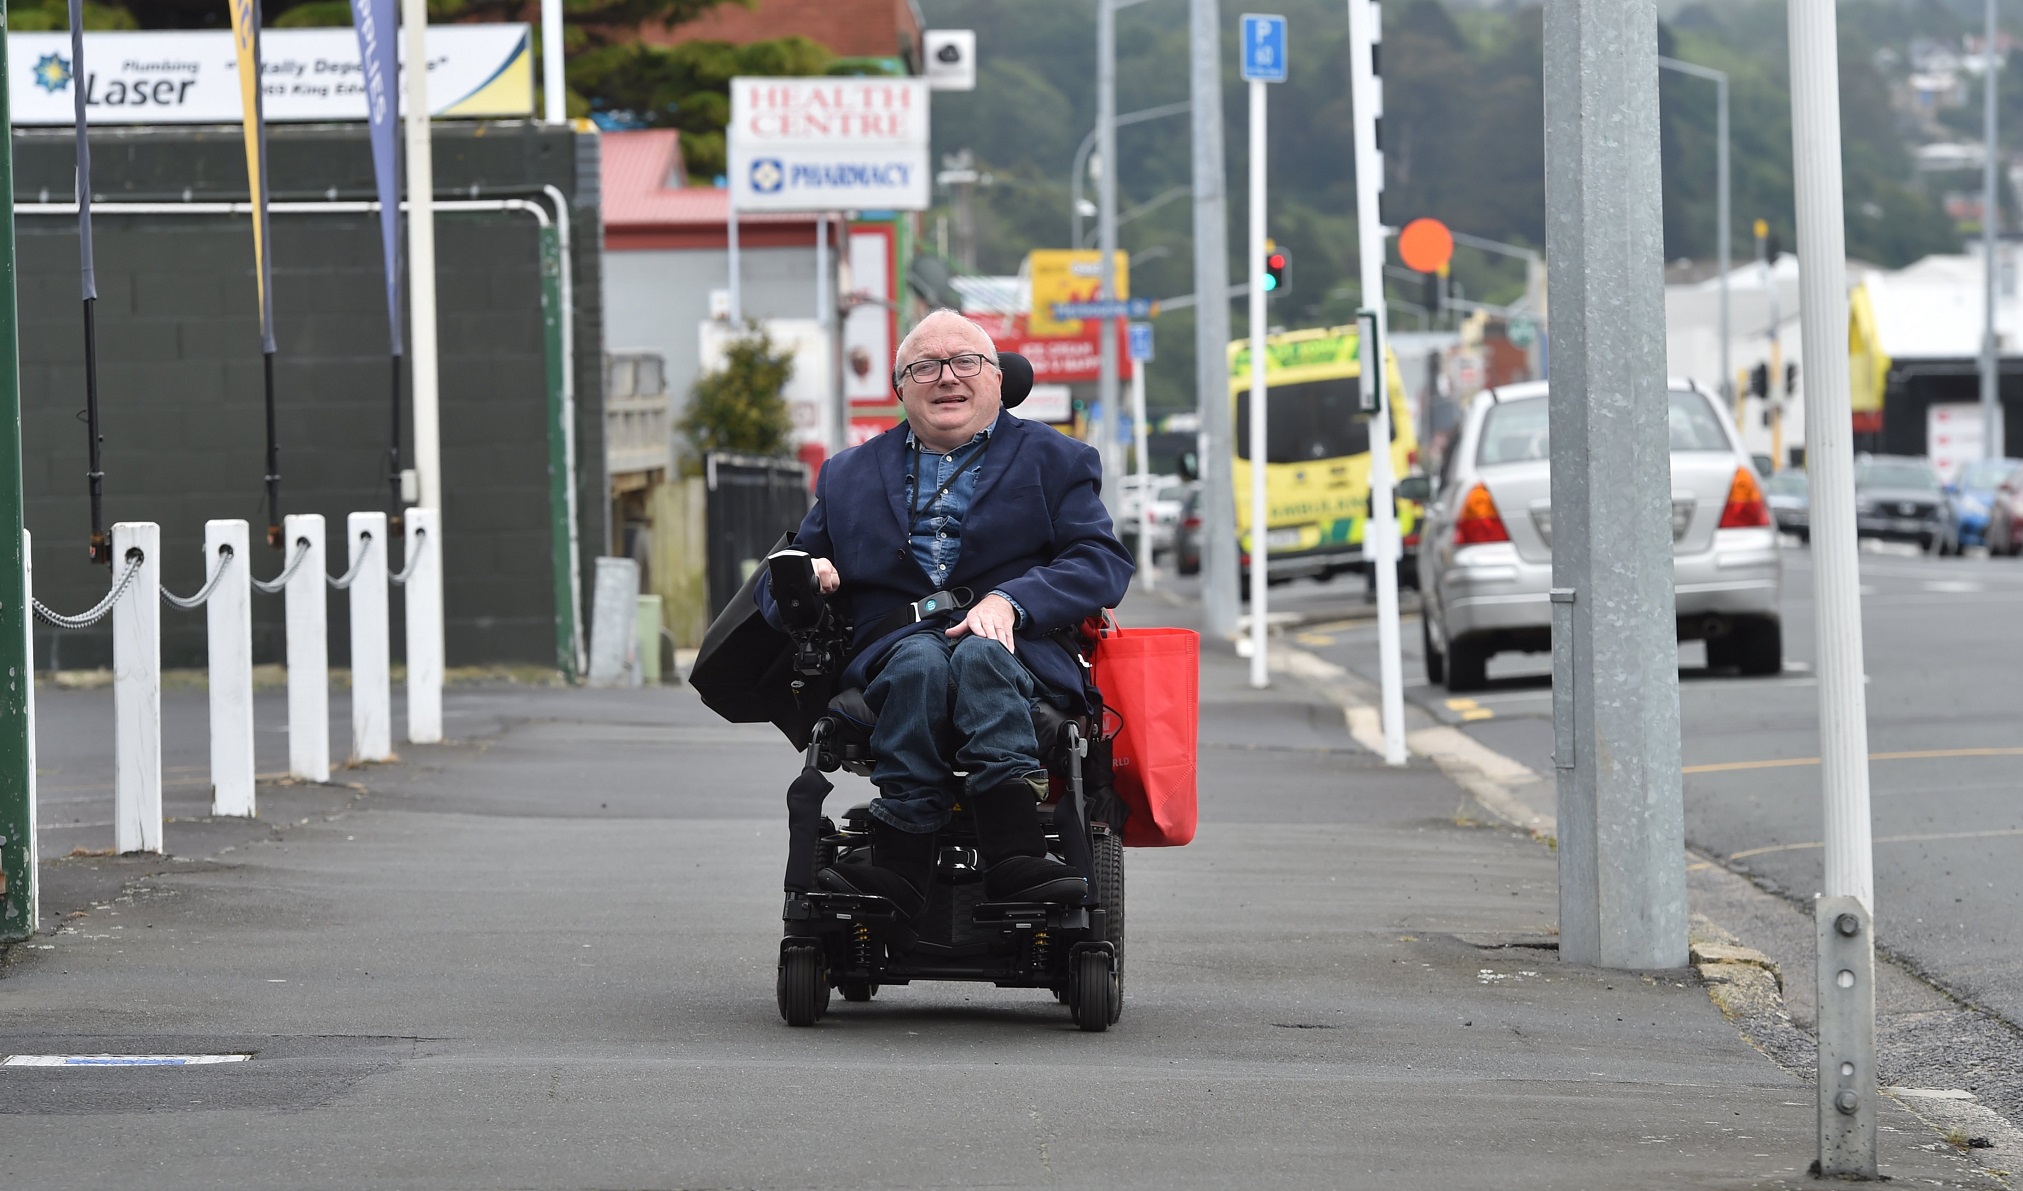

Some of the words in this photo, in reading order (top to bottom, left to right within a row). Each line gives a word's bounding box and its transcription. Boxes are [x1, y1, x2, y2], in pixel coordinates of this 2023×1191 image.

[1255, 20, 1272, 44] P
[121, 60, 199, 73] Plumbing
[85, 73, 195, 106] Laser
[750, 85, 910, 109] HEALTH
[750, 112, 907, 137] CENTRE
[791, 163, 911, 189] PHARMACY
[1112, 757, 1130, 767] RLD
